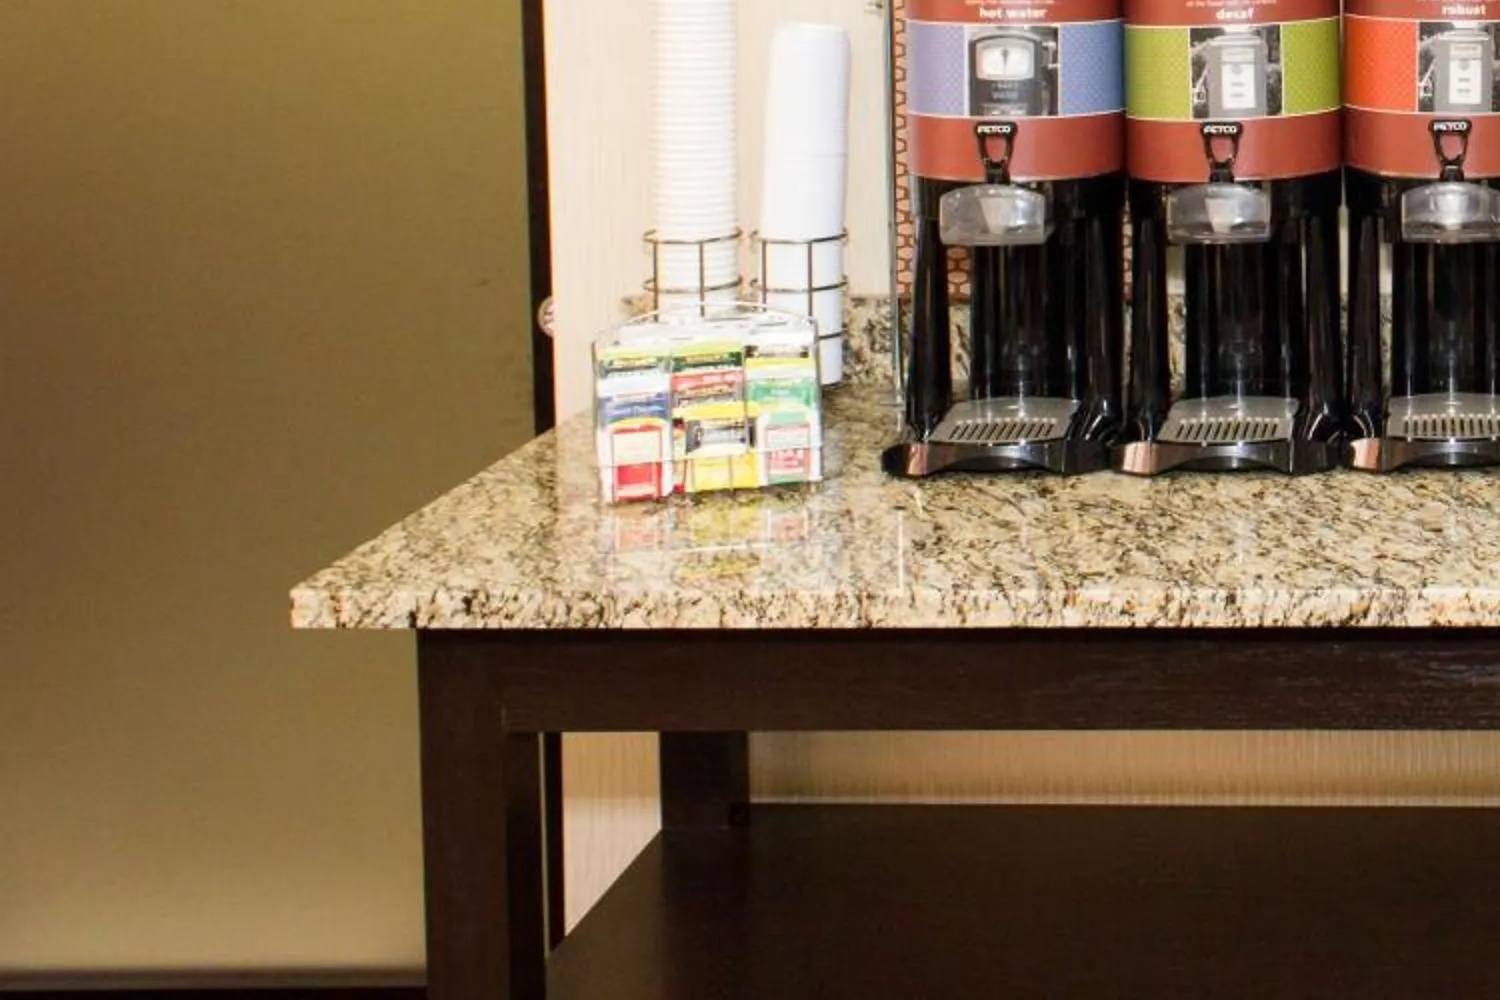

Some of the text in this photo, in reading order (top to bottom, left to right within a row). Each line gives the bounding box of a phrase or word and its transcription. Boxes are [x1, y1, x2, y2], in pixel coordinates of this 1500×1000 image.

[979, 6, 1048, 19] hot water
[1441, 3, 1487, 16] robust
